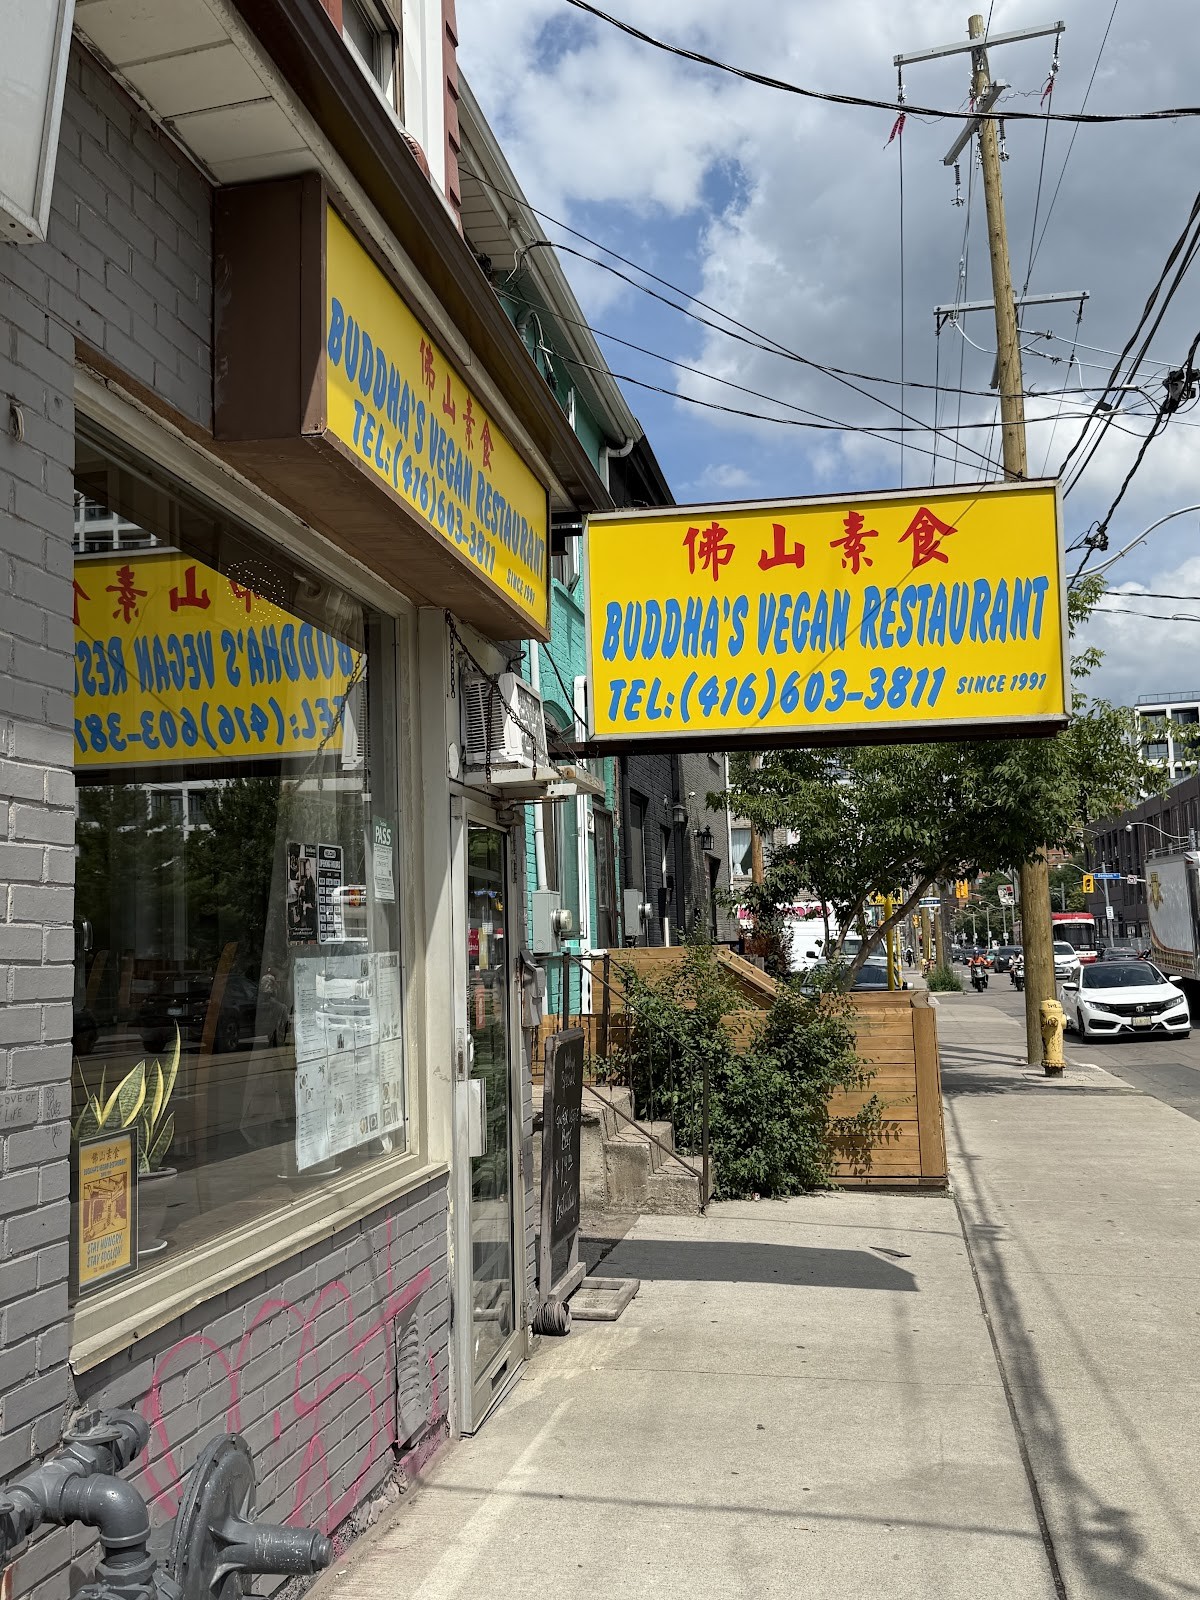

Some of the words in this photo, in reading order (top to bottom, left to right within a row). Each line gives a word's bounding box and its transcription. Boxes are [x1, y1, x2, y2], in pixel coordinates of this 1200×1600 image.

[327, 297, 426, 455] BUDDHA'S
[428, 413, 475, 510] VEGAN
[476, 470, 546, 583] RESTAURANT
[419, 337, 495, 473] 佛山素食
[682, 506, 958, 582] 佛山素食
[506, 568, 524, 596] SINCE
[523, 584, 536, 607] 1991
[601, 593, 750, 662] BUDDHA'S
[756, 588, 851, 656] VEGAN
[859, 575, 1050, 650] RESTAURANT
[956, 673, 1007, 695] SINCE
[1011, 672, 1047, 692] 1991
[375, 825, 392, 846] PASS
